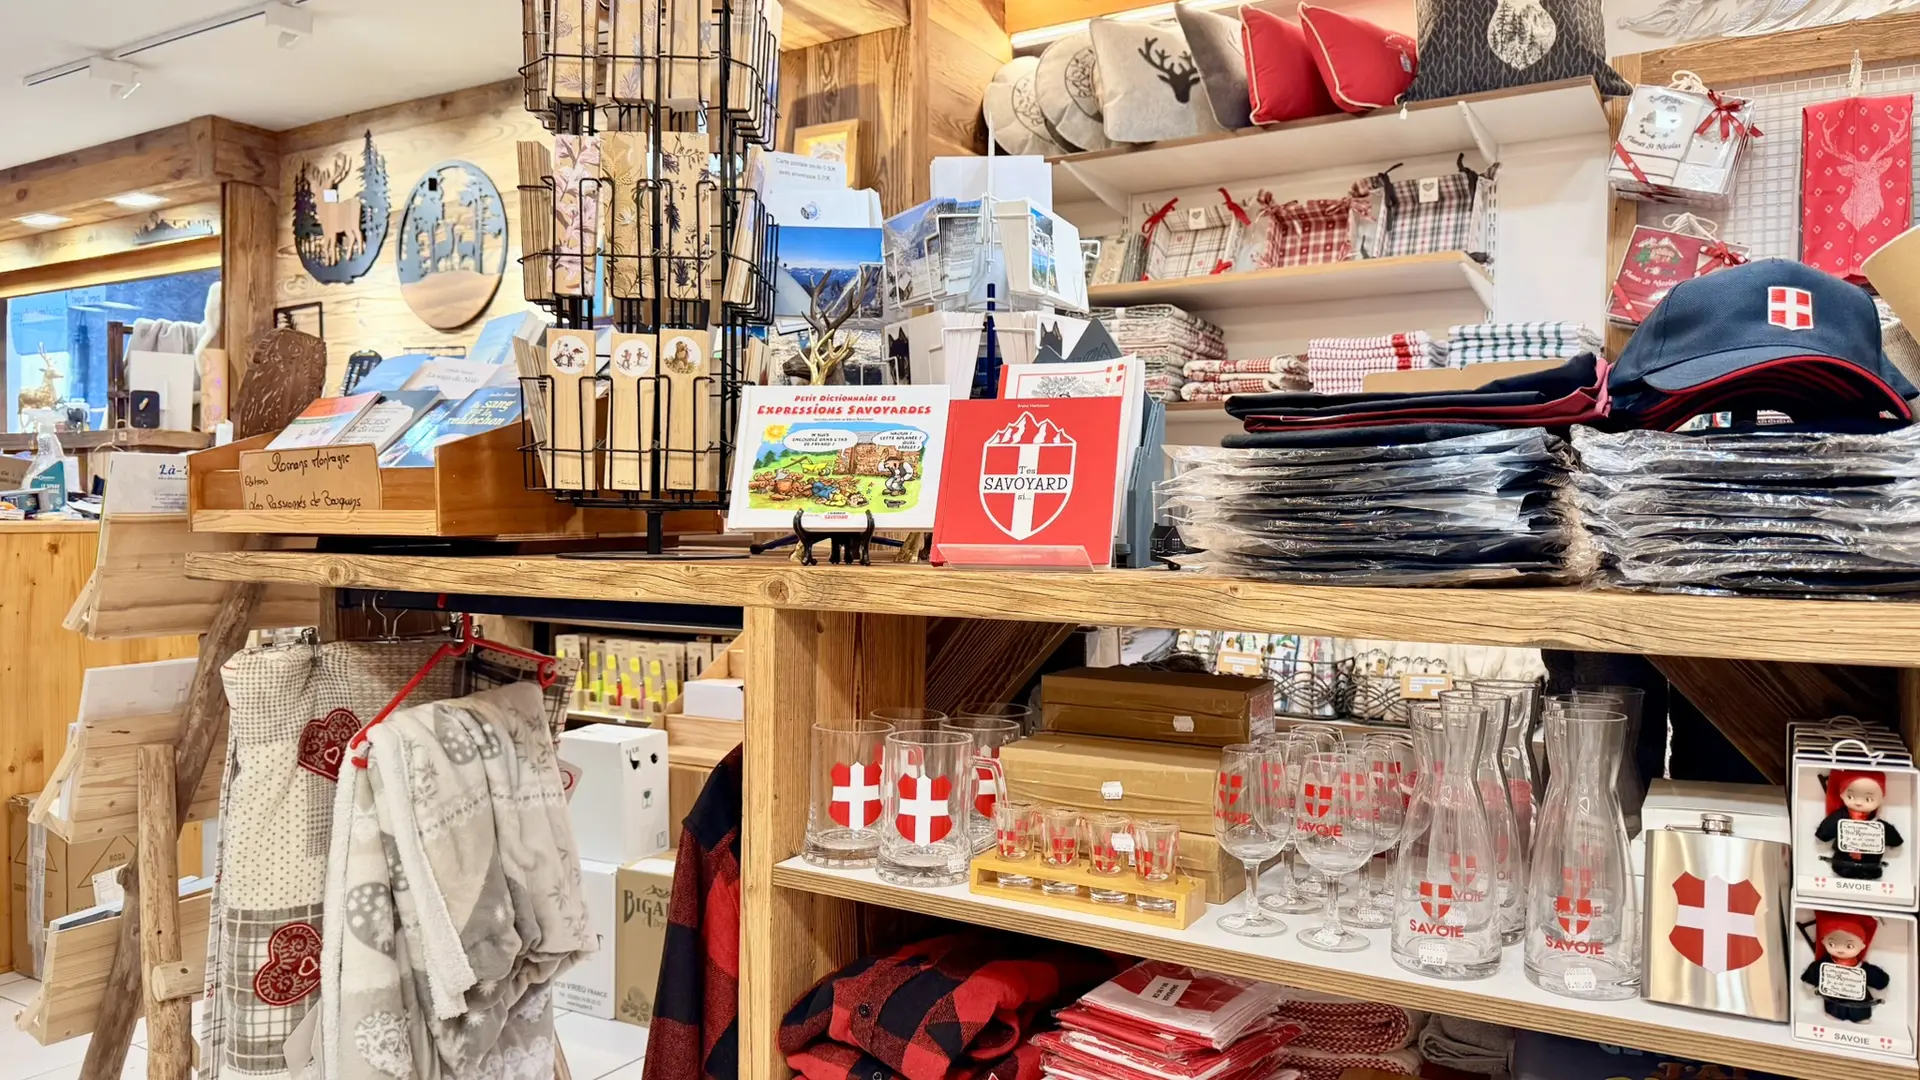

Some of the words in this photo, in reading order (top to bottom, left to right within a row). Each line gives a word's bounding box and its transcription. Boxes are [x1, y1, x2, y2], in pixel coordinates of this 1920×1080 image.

[1656, 141, 1681, 151] Nicolas
[757, 403, 842, 415] EXPRESSIONS
[847, 405, 932, 415] SAVOYARDES
[268, 452, 308, 475] Romans
[311, 450, 350, 470] Montagne
[983, 477, 1068, 490] SAVOYARD
[250, 493, 264, 510] Les
[310, 491, 321, 507] de
[1297, 819, 1343, 837] SAVOIE
[1836, 881, 1872, 891] SAVOIE
[1409, 919, 1464, 938] SAVOIE
[1545, 935, 1605, 955] SAVOIE
[1834, 1033, 1870, 1045] SAVOIE
